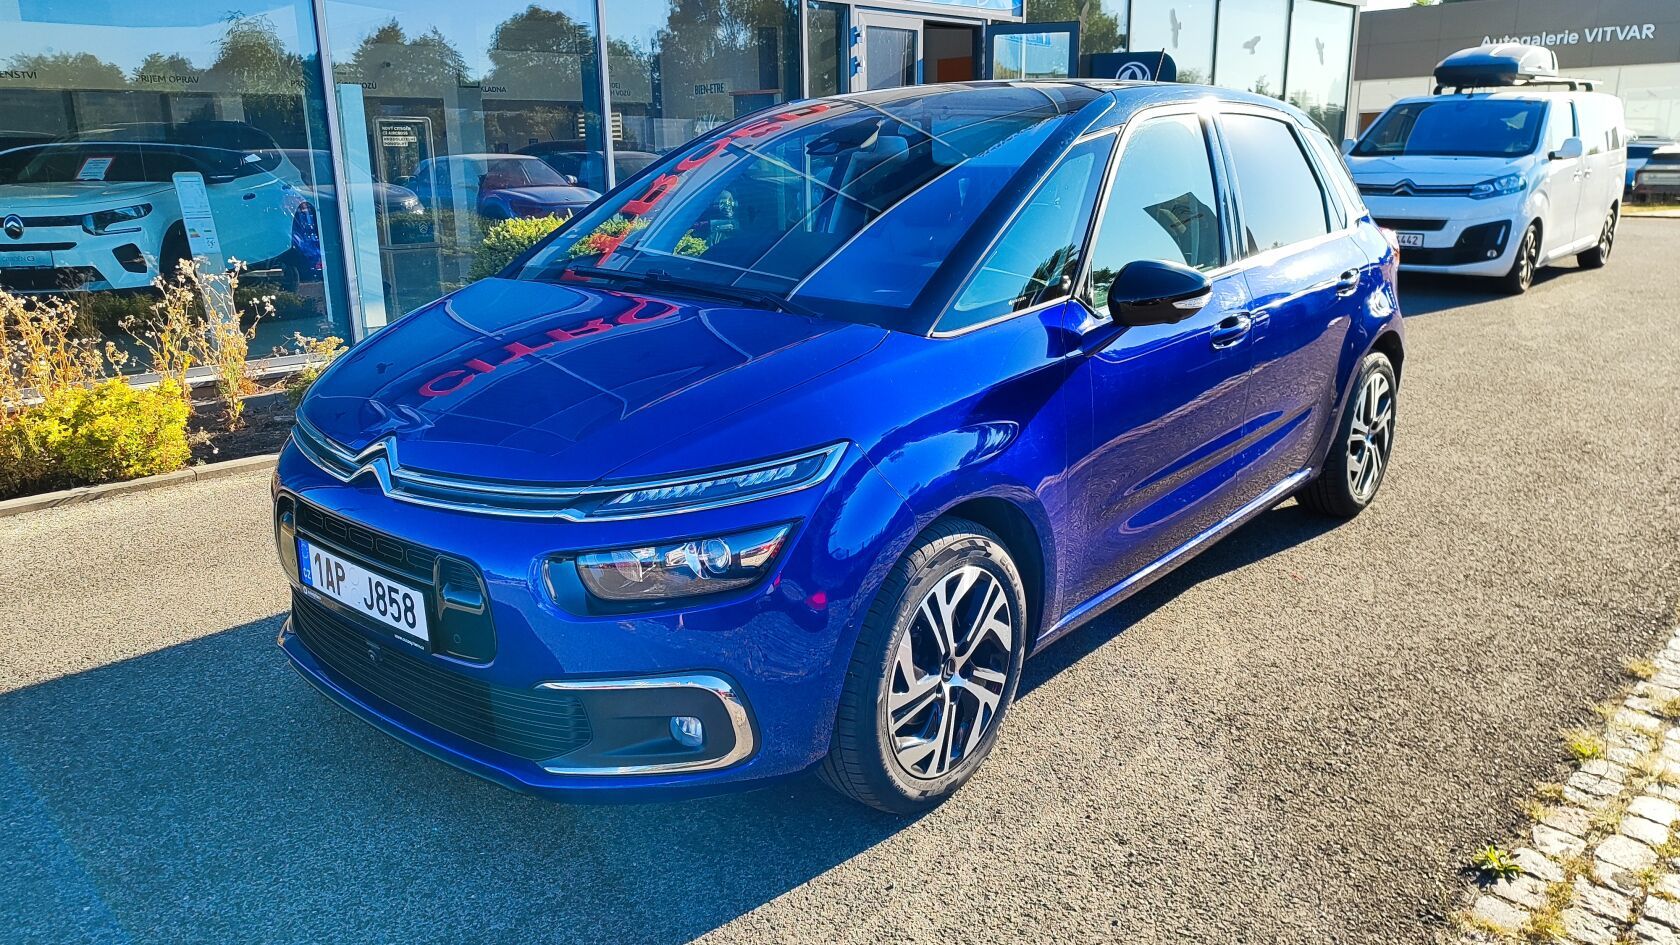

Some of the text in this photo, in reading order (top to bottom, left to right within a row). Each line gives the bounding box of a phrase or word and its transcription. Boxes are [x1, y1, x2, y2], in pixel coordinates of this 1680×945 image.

[1584, 23, 1656, 43] VITVAR
[168, 75, 199, 84] OPRAV
[303, 567, 312, 580] CZ
[314, 552, 417, 630] 1AP J858
